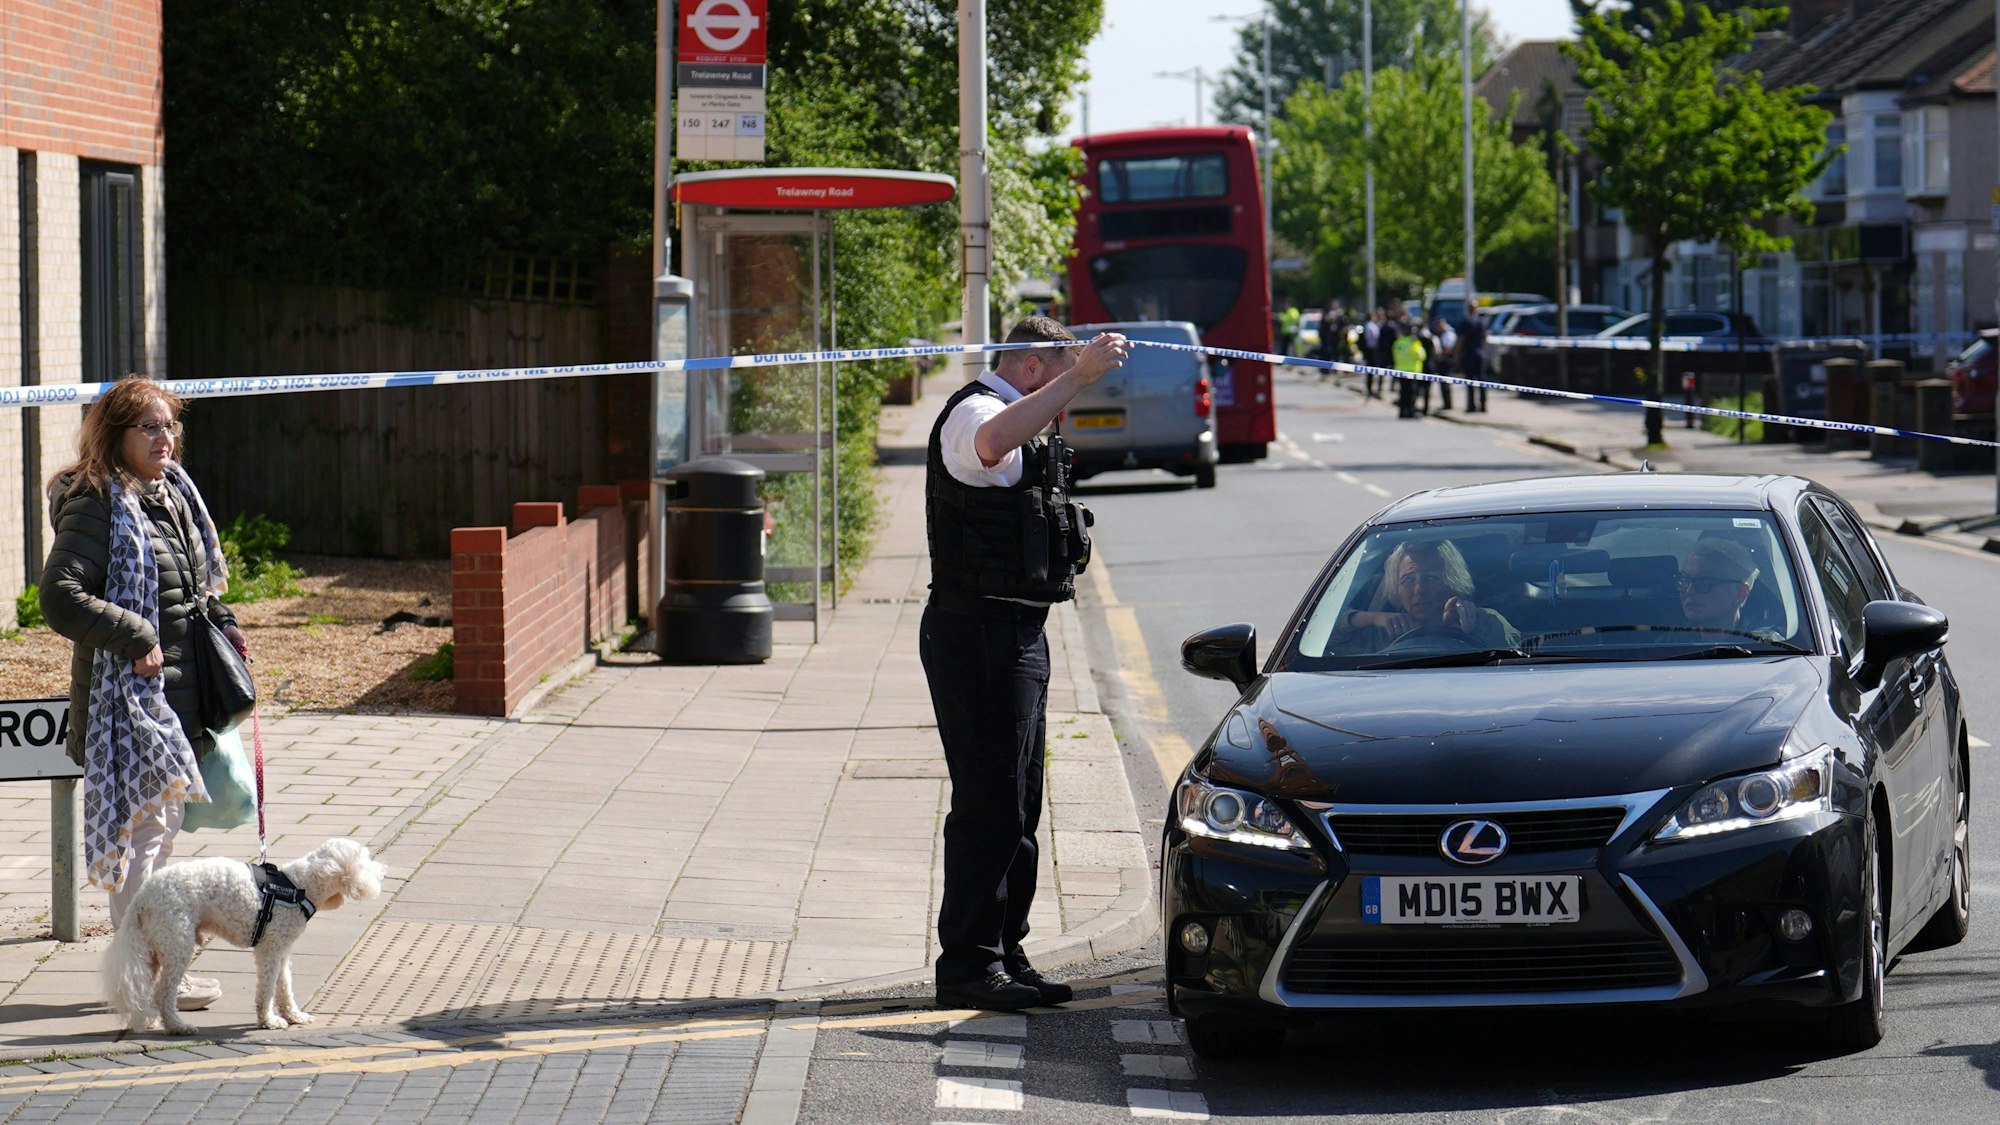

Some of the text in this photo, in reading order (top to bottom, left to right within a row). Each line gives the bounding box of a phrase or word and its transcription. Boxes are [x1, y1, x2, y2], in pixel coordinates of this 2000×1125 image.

[690, 71, 753, 81] Trelawney Road
[683, 118, 700, 127] 150
[711, 119, 730, 128] 247
[742, 119, 757, 128] N8
[776, 186, 854, 198] Trelawney Road
[1398, 880, 1569, 917] MD15 BWX
[1365, 904, 1378, 915] GB
